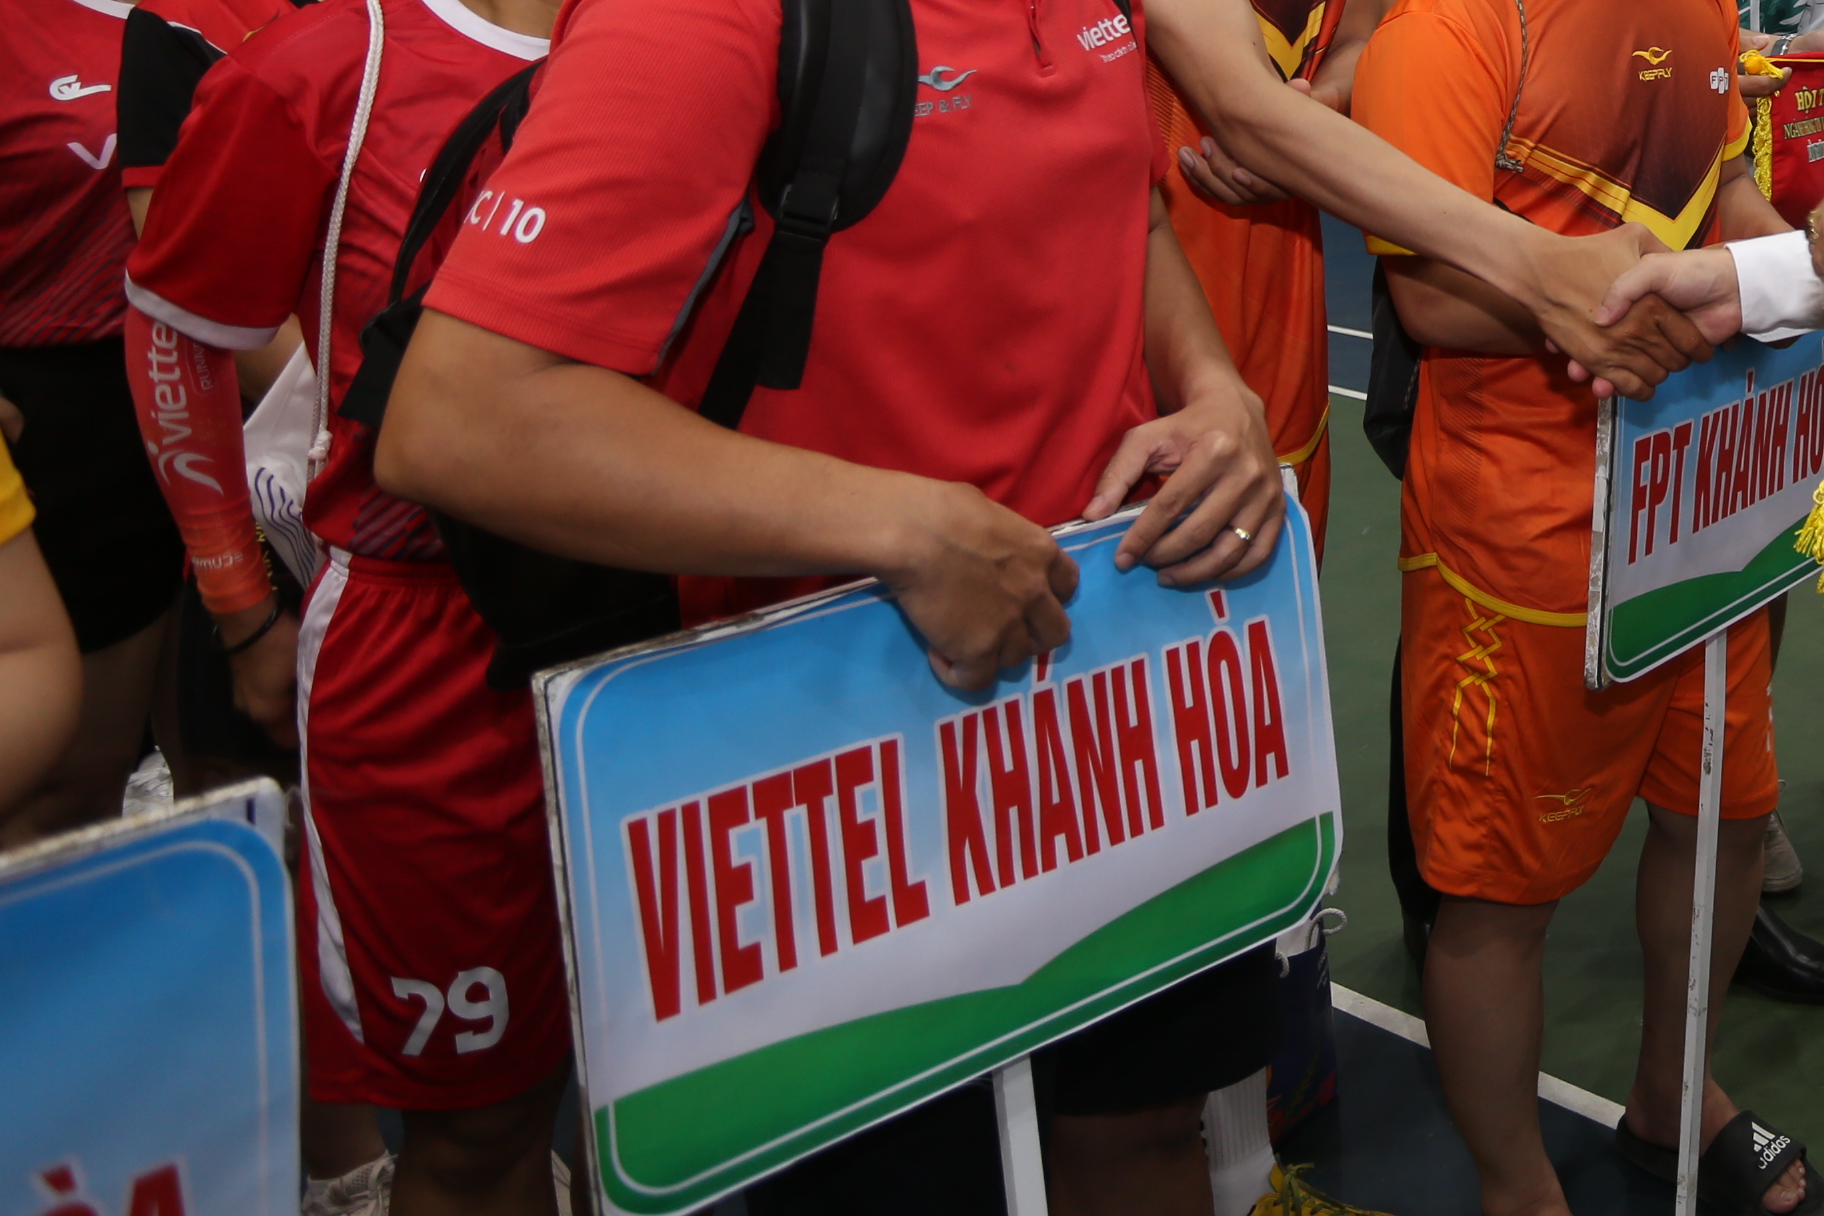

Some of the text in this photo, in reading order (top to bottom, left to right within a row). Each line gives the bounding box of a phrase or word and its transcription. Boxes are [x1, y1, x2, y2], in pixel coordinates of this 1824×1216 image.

[1077, 14, 1131, 51] viette
[1795, 86, 1818, 114] HỘI
[148, 323, 193, 445] viette
[1628, 422, 1693, 566] FPT
[1692, 367, 1795, 536] KHÁNH
[625, 589, 1291, 1023] VIETTEL KHÁNH HÒA
[391, 966, 509, 1056] 79
